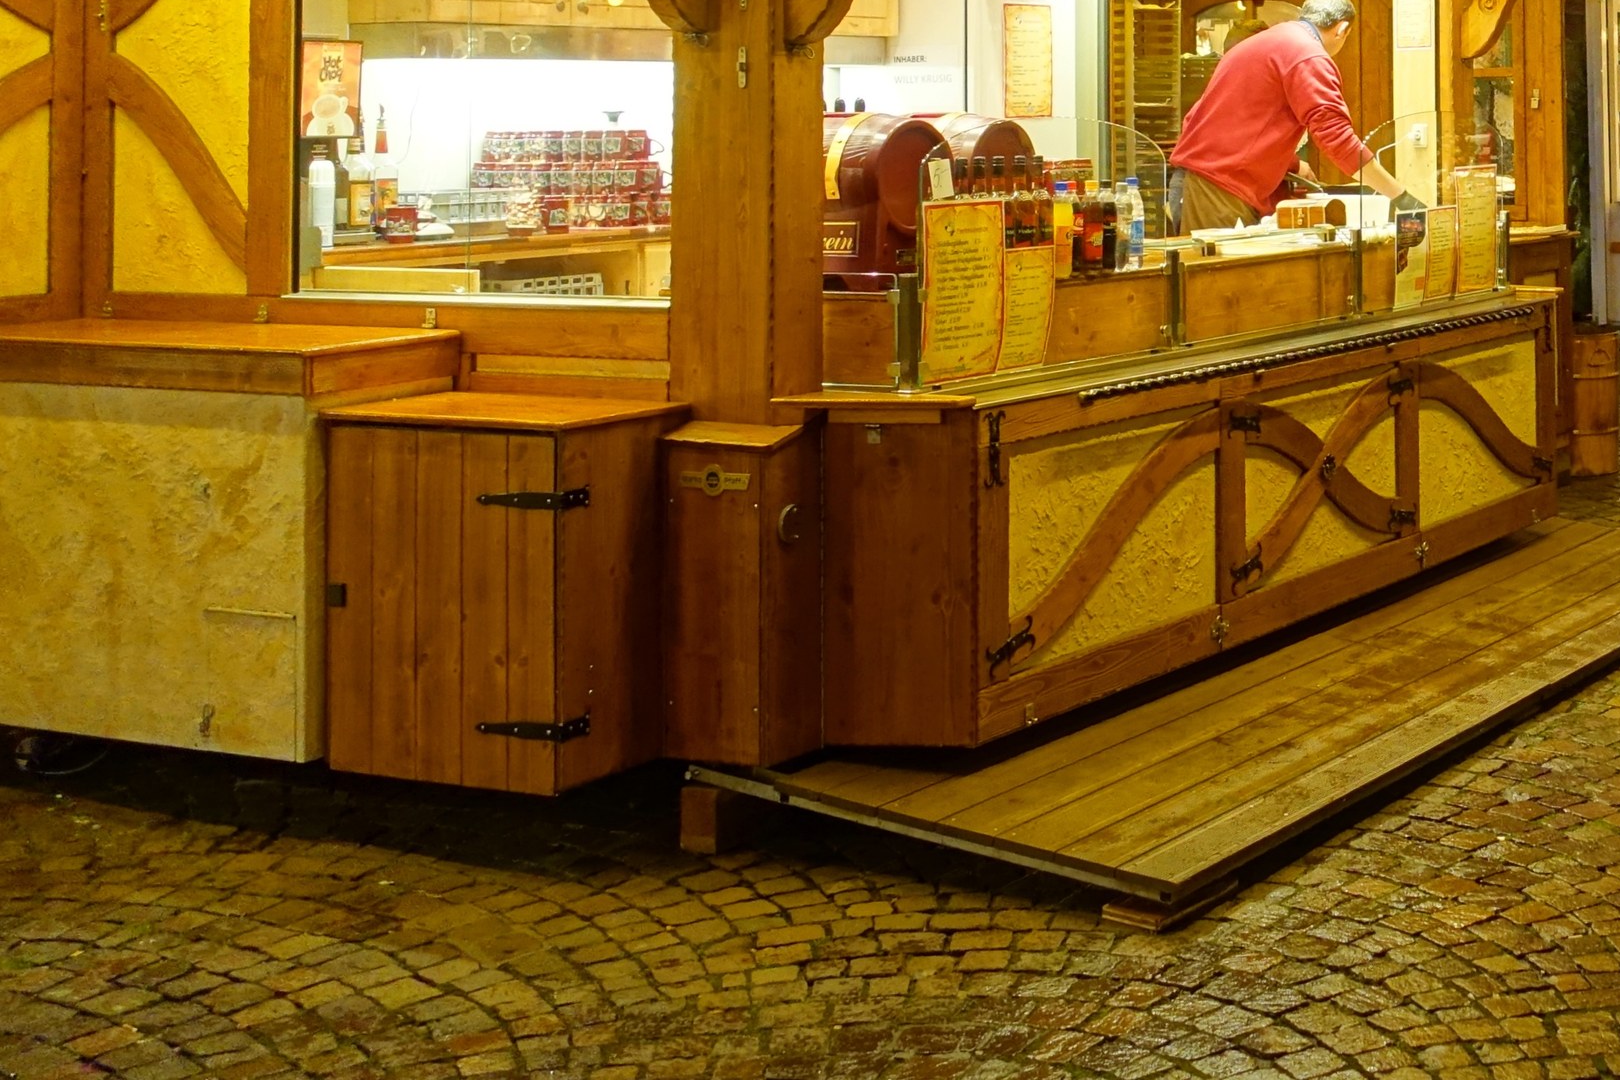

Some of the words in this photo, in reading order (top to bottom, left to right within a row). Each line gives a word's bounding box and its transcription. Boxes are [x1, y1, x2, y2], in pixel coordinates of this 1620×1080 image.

[323, 56, 343, 69] Hot
[893, 55, 928, 63] INHABER:
[822, 230, 854, 251] ein
